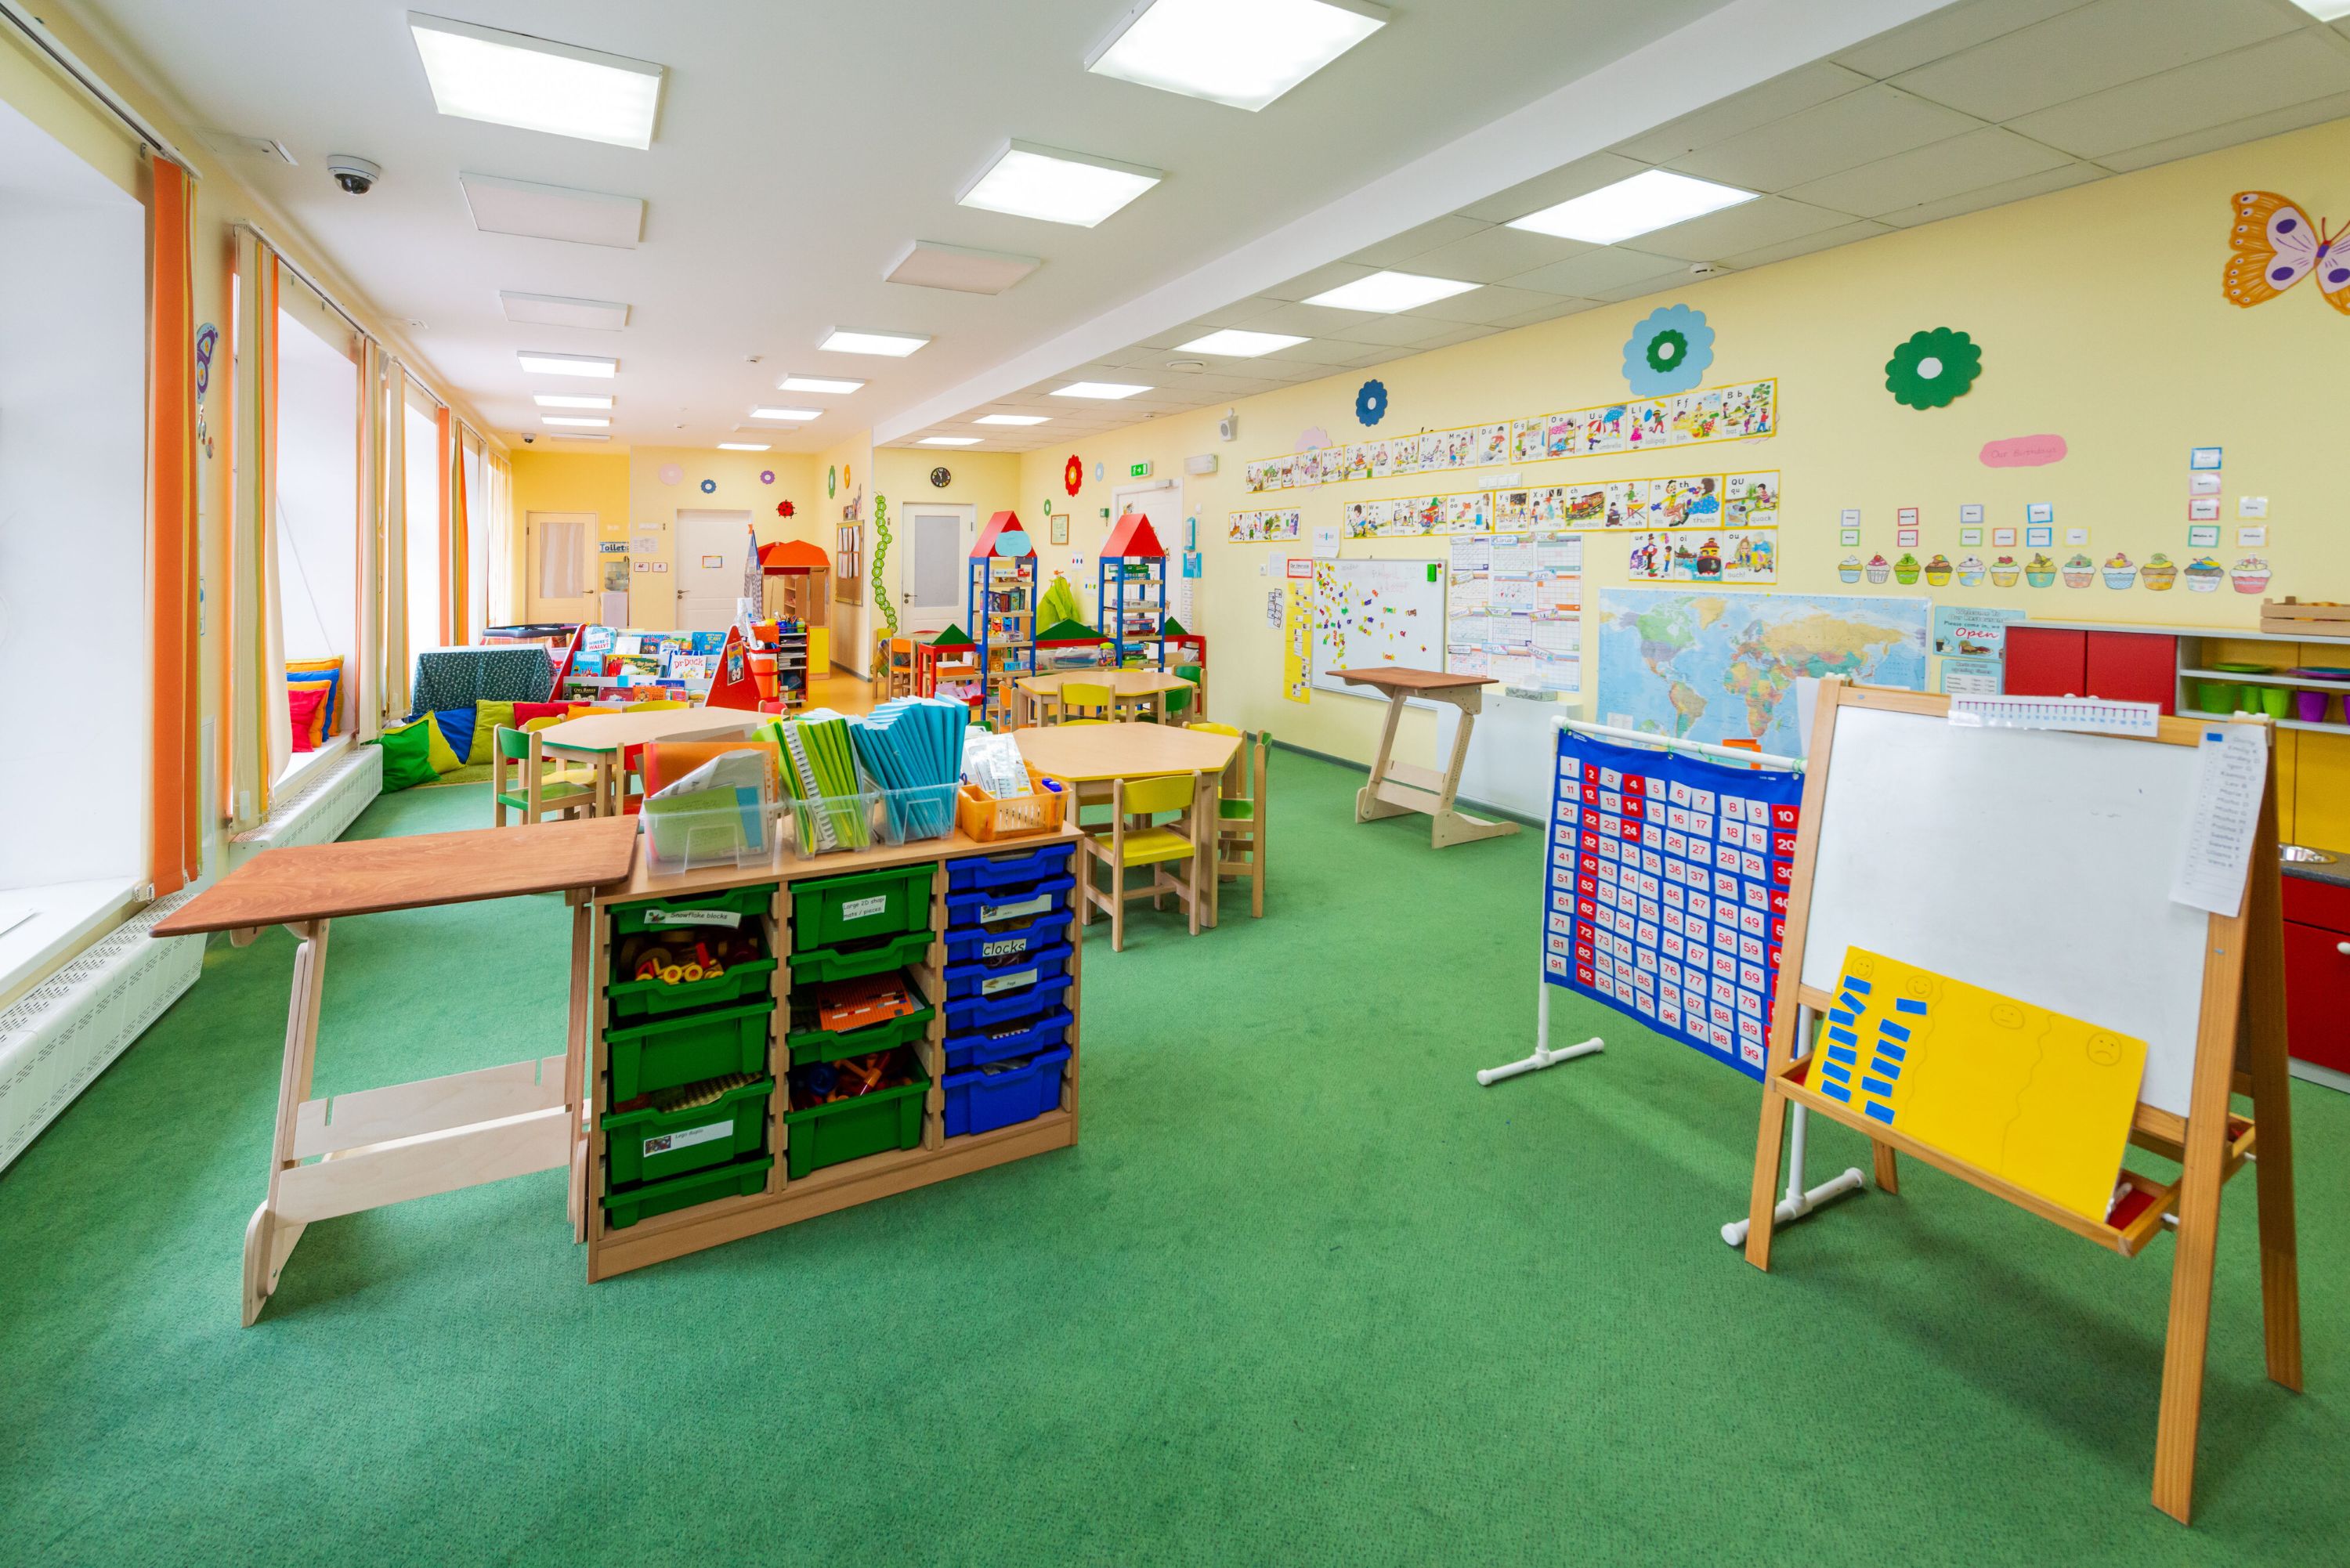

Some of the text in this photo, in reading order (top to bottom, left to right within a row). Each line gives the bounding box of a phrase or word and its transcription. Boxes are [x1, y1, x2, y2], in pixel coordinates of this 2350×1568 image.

[1684, 399, 1689, 408] f
[1955, 627, 1998, 639] Open
[1585, 790, 1594, 799] 12
[1605, 797, 1617, 807] 13
[1626, 801, 1638, 811] 14
[1652, 807, 1661, 817] 15
[1673, 814, 1685, 825] 16
[1696, 819, 1708, 829] 17
[1726, 826, 1738, 838] 18
[1752, 833, 1762, 844] 19
[1778, 840, 1795, 851] 20
[1589, 770, 1594, 779] 2
[1630, 780, 1637, 789] 4
[1653, 783, 1660, 794] 5
[1676, 789, 1684, 799] 6
[1700, 795, 1708, 805] 7
[1729, 802, 1738, 812] 8
[1755, 807, 1762, 818] 9
[1778, 811, 1794, 822] 10
[1561, 830, 1764, 902] 31 32 33 34 35 36 37 38 39
[1563, 807, 1574, 816] 21
[1585, 814, 1596, 825] 22
[1603, 820, 1617, 831] 23
[1624, 825, 1637, 836] 24
[1646, 830, 1658, 842] 25
[1668, 836, 1682, 849] 26
[1691, 844, 1705, 854] 27
[1720, 851, 1736, 865] 28
[1745, 858, 1760, 872] 29
[863, 907, 881, 916] pieces
[1556, 873, 1759, 956] 51 52 53 54 55 56 57 58 59
[1558, 852, 1760, 928] 41 42 43 44 45 46 47 48 49
[983, 940, 1025, 956] clocks
[1555, 918, 1757, 1009] 71 72 73 74 75 76 77 78 79
[1558, 896, 1760, 984] 61 62 63 64 65 66 67 68 69
[1552, 959, 1759, 1060] 91 92 93 94 95 96 97 98 99
[1578, 947, 1590, 959] 82
[1599, 956, 1610, 967] 83
[1618, 965, 1630, 977] 84
[1637, 974, 1650, 988] 85
[1663, 986, 1676, 999] 86
[1687, 997, 1701, 1009] 87
[1714, 1008, 1730, 1022] 88
[1742, 1021, 1759, 1035] 89
